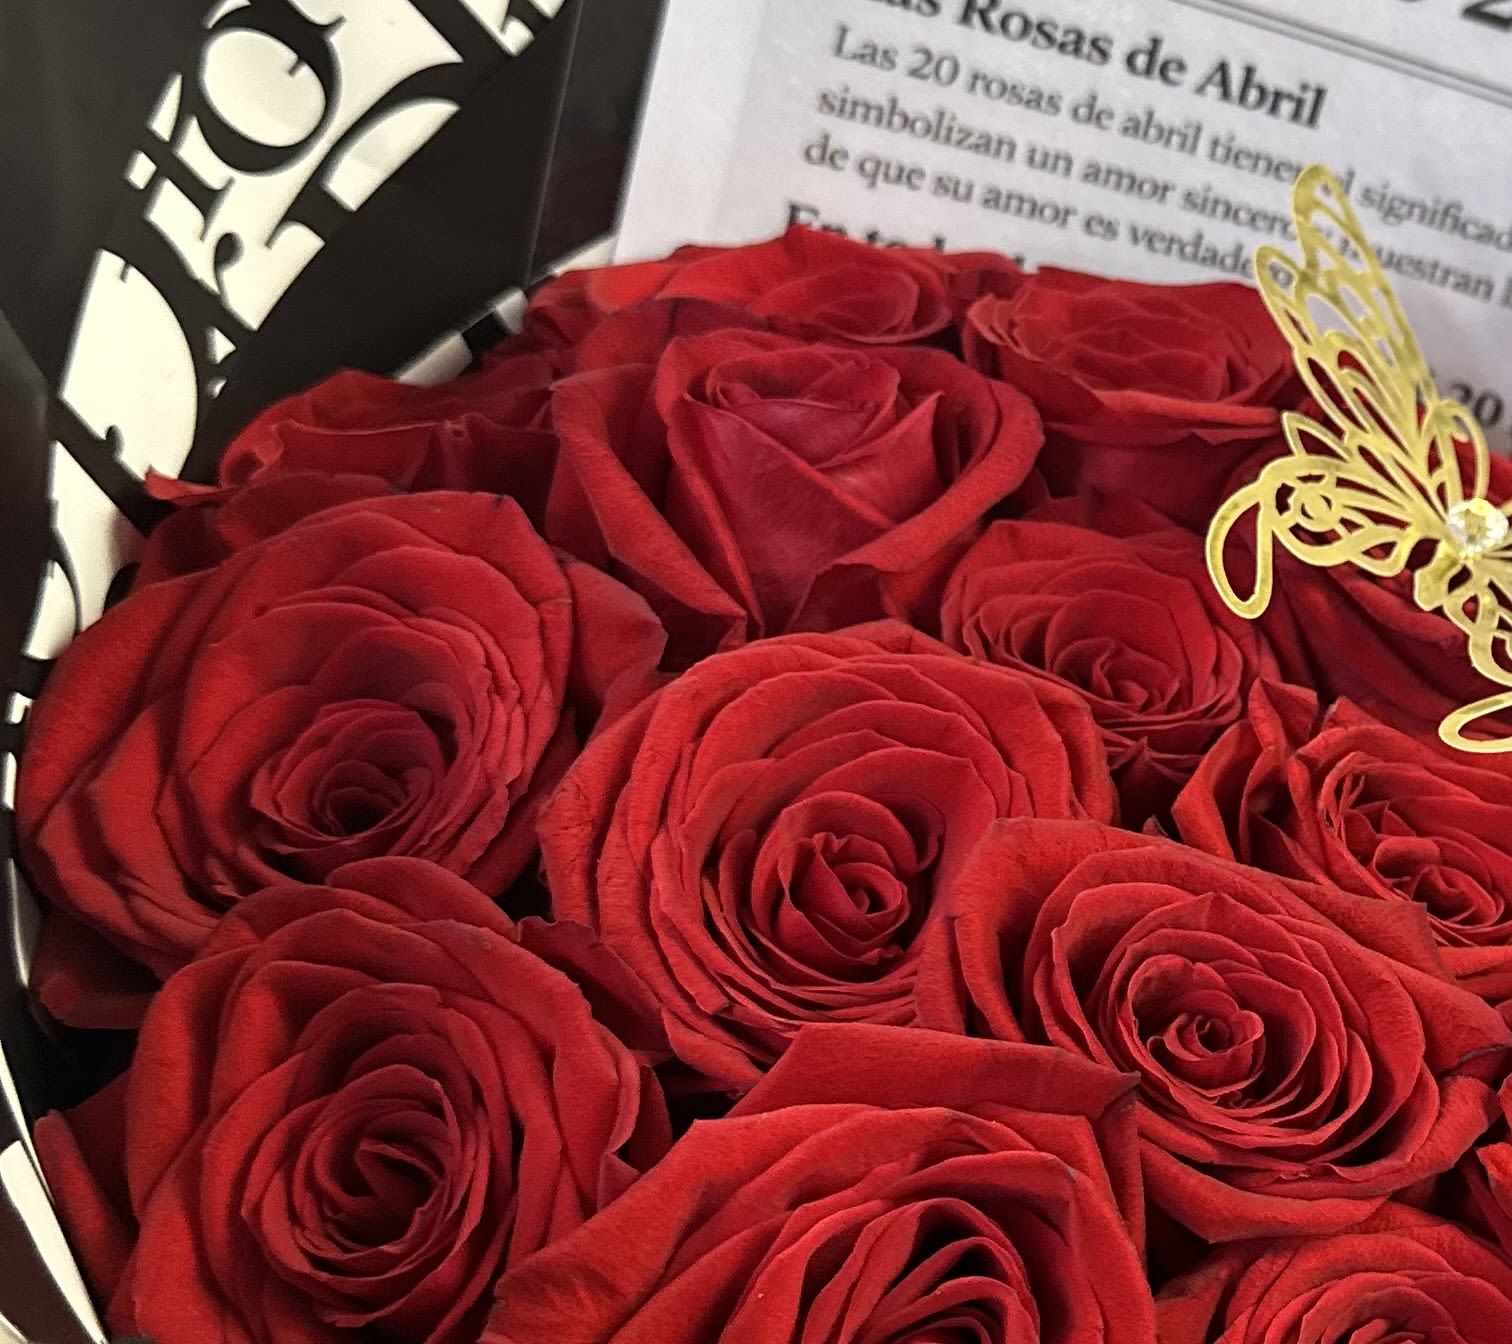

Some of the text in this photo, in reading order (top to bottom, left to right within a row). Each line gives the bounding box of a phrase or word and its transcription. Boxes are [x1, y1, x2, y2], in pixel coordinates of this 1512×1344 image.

[833, 24, 897, 71] Las
[910, 46, 960, 87] 20
[968, 68, 1061, 116] rosas
[1071, 92, 1116, 130] de
[1123, 107, 1202, 163] abril
[1207, 134, 1302, 183] tiene
[1125, 37, 1188, 86] de
[1194, 63, 1326, 129] Abril
[804, 132, 849, 170] de
[857, 154, 926, 198] que
[931, 174, 974, 204] su
[980, 188, 1077, 228] amor
[1083, 214, 1120, 240] es
[816, 86, 1015, 163] simbolizan
[1024, 140, 1075, 177] un
[1081, 161, 1177, 203] amor
